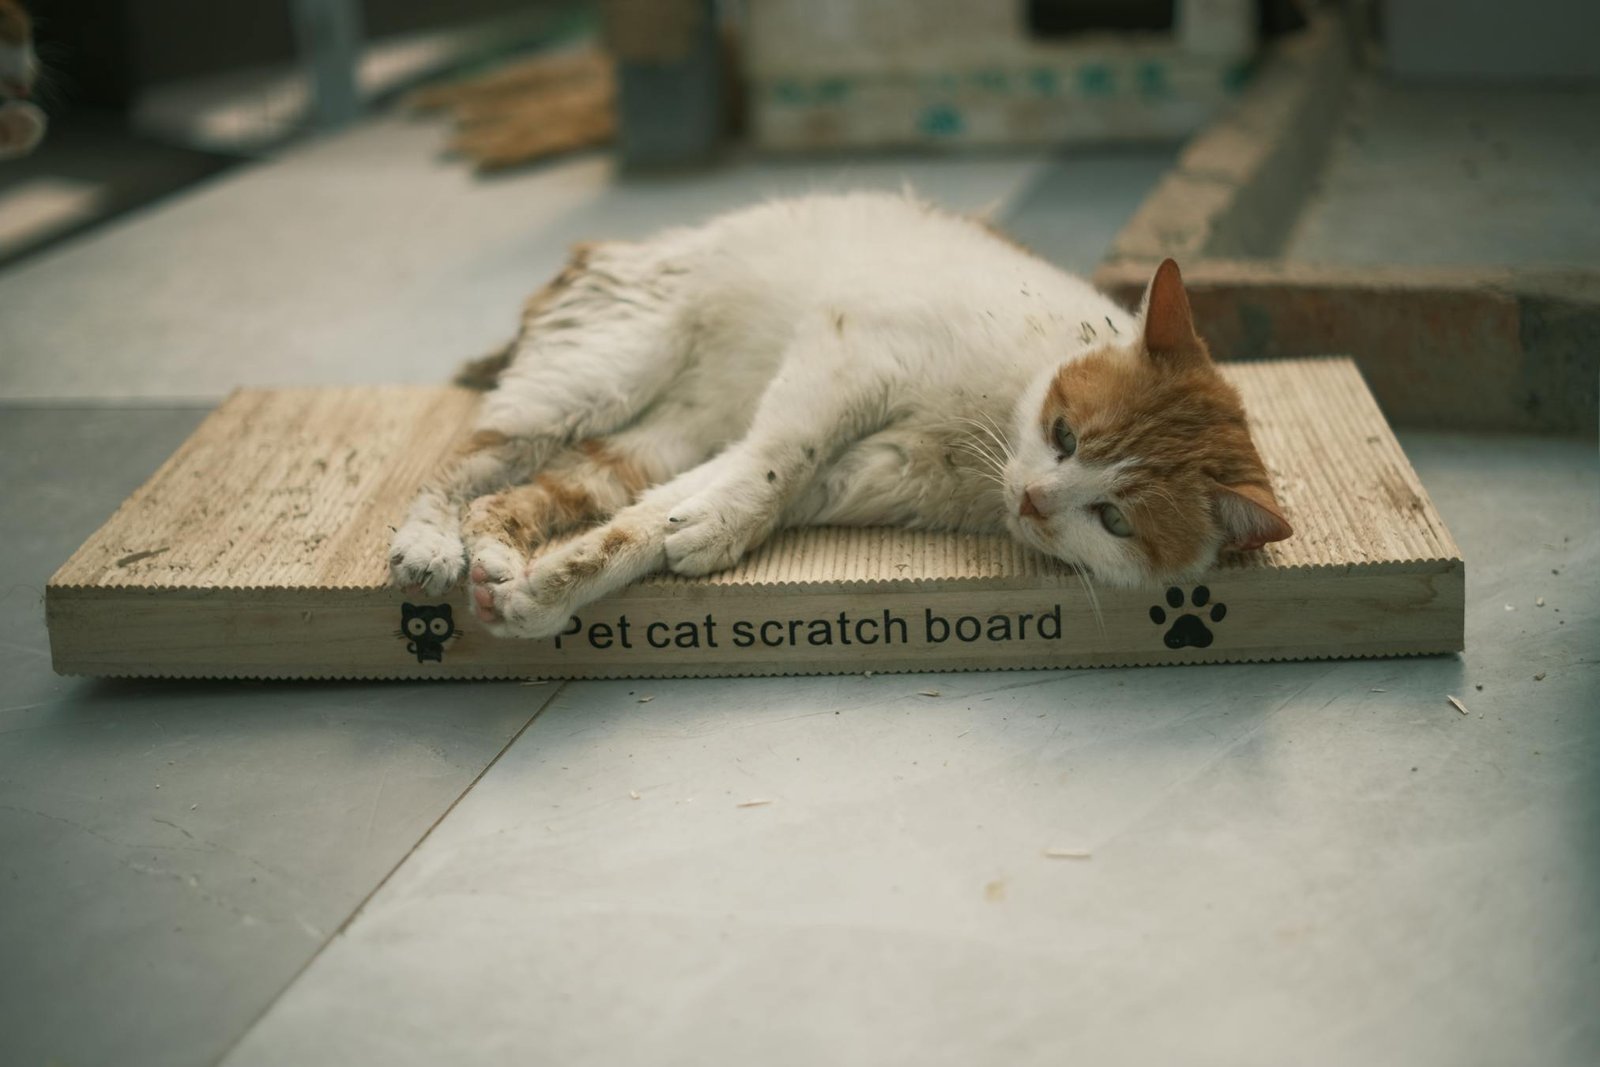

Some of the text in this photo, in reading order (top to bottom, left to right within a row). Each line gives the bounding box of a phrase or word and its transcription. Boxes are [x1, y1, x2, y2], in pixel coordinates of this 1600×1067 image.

[554, 604, 1062, 650] Pet cat scratch board
